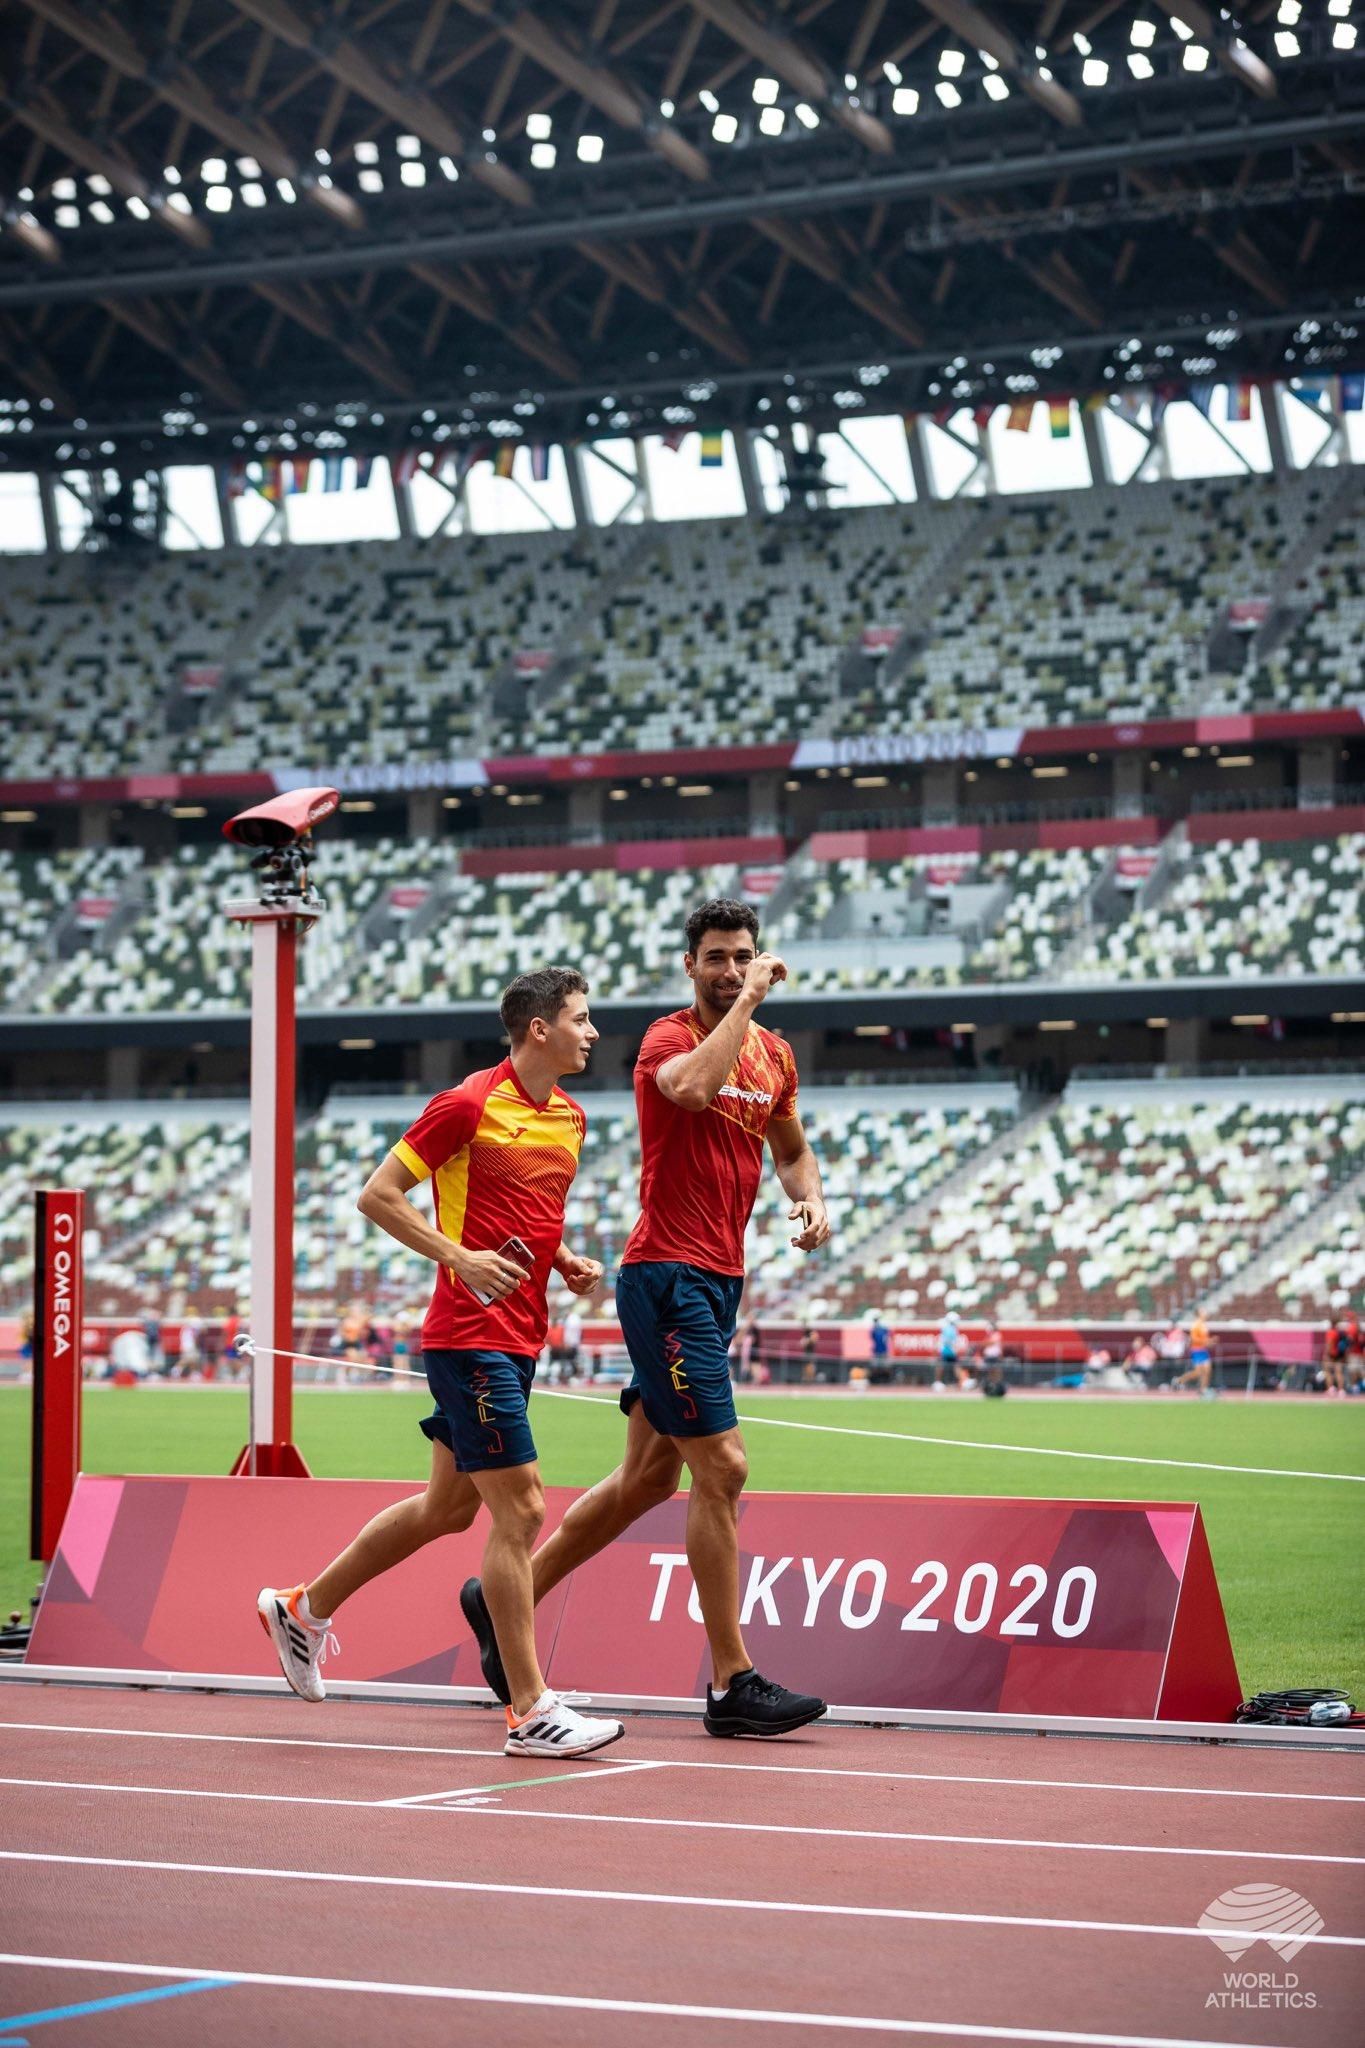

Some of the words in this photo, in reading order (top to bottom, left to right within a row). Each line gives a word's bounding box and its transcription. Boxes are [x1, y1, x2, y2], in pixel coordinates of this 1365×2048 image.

[53, 1250, 72, 1359] OMEGA
[648, 1552, 888, 1630] TKYO
[900, 1560, 1098, 1638] 2020
